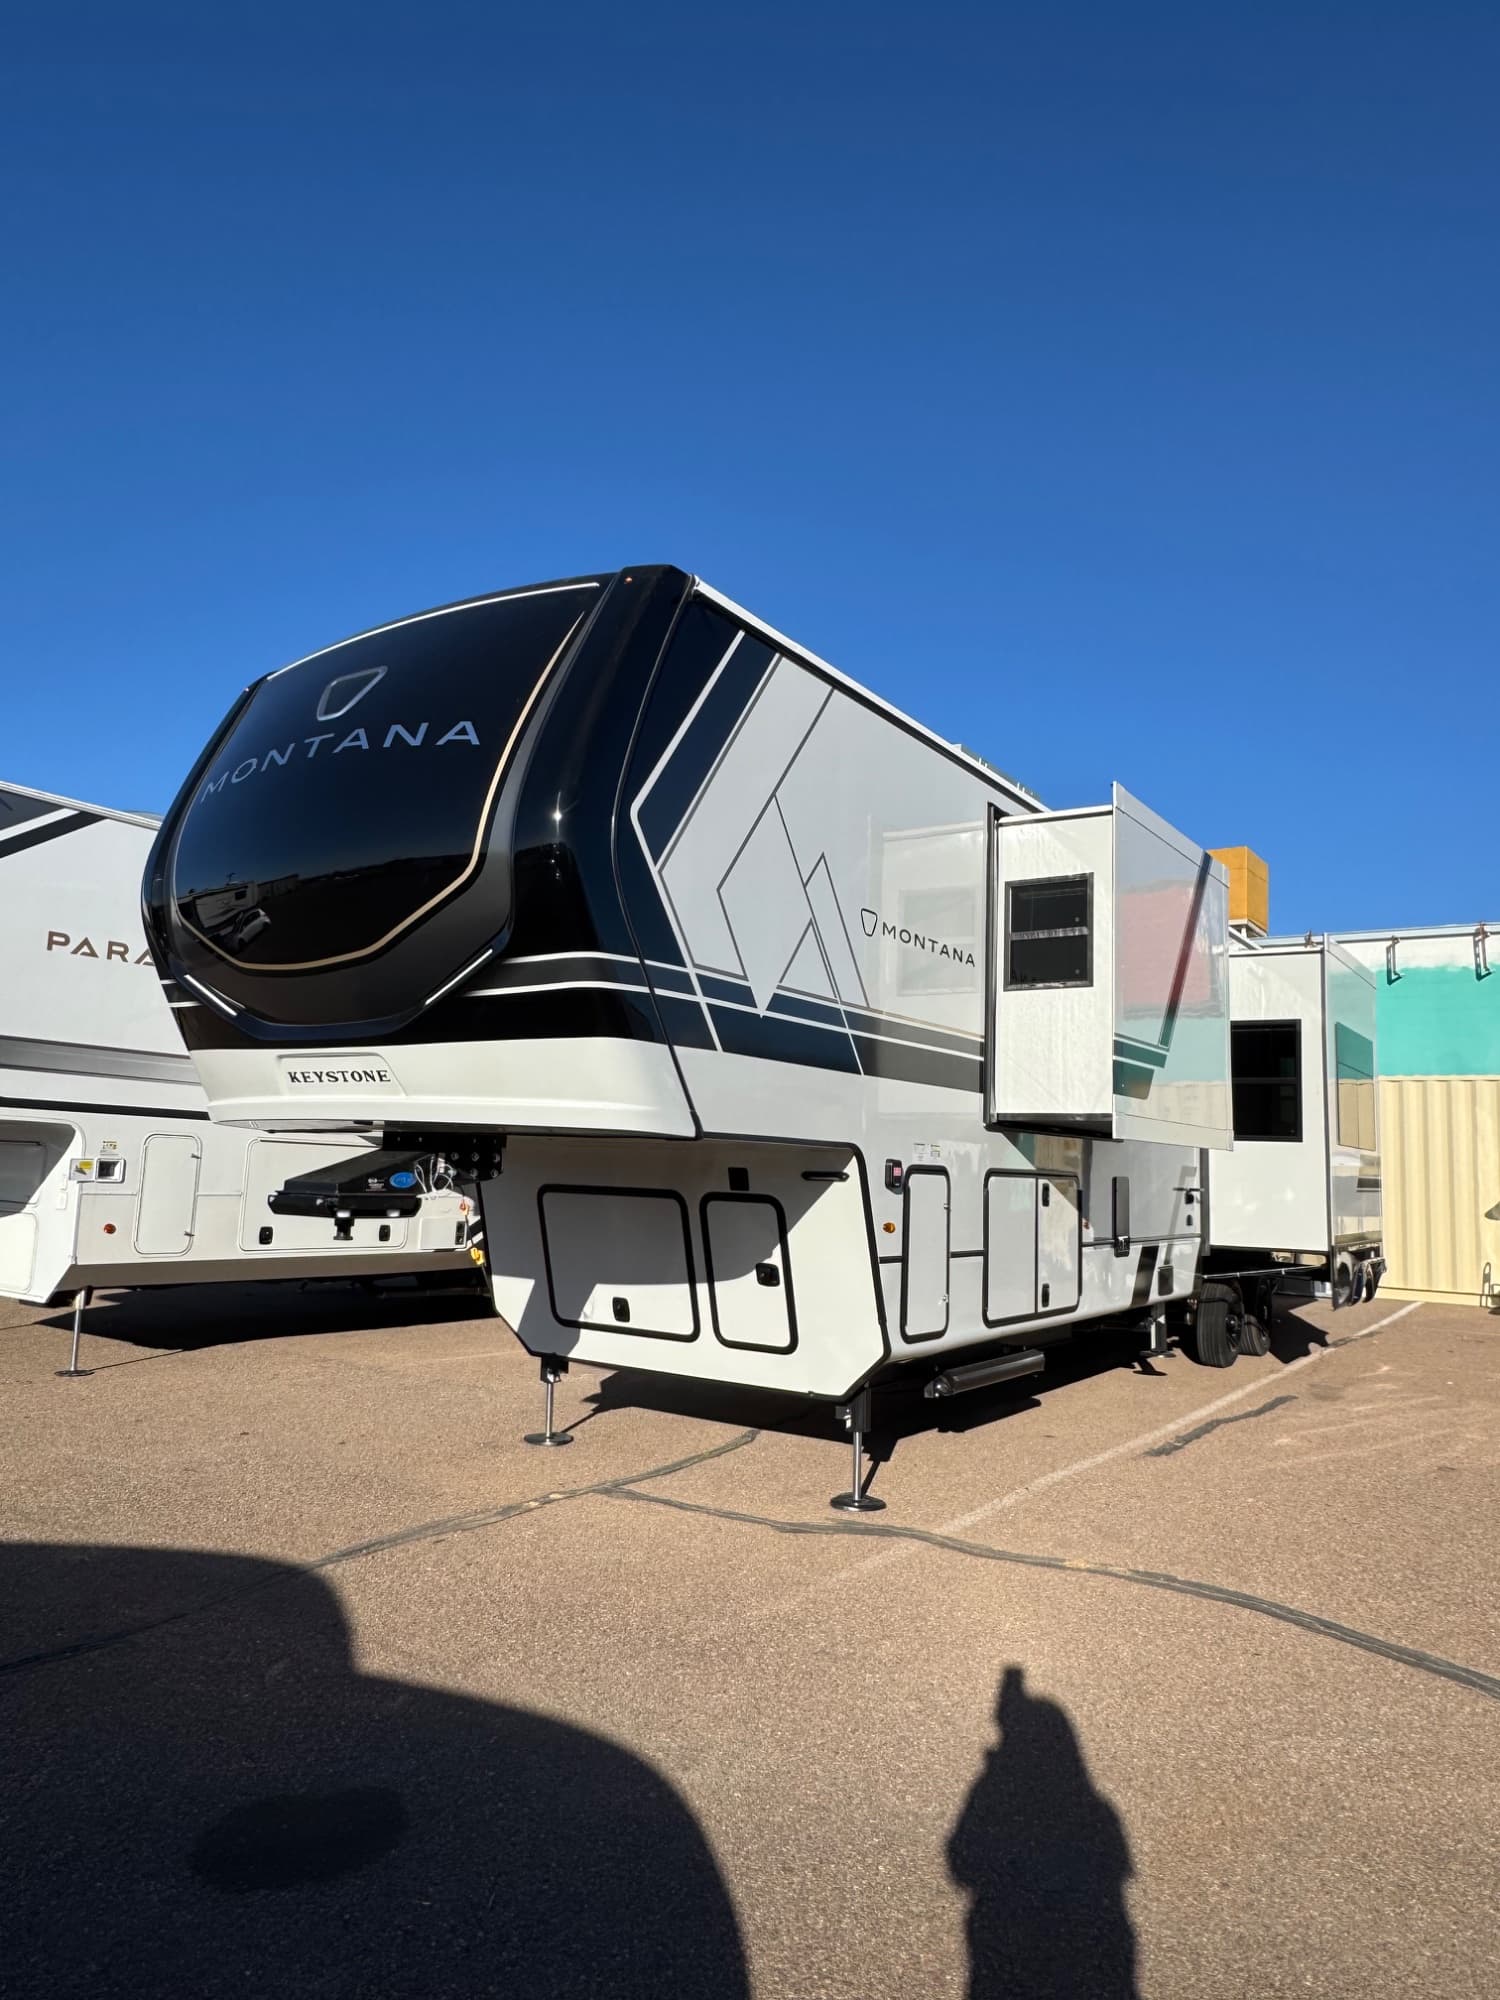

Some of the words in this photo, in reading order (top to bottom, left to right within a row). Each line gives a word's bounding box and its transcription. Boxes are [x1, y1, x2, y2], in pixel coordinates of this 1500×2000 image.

[200, 720, 481, 802] MONTANA
[882, 921, 975, 967] MONTANA
[287, 1069, 392, 1084] KEYSTONE
